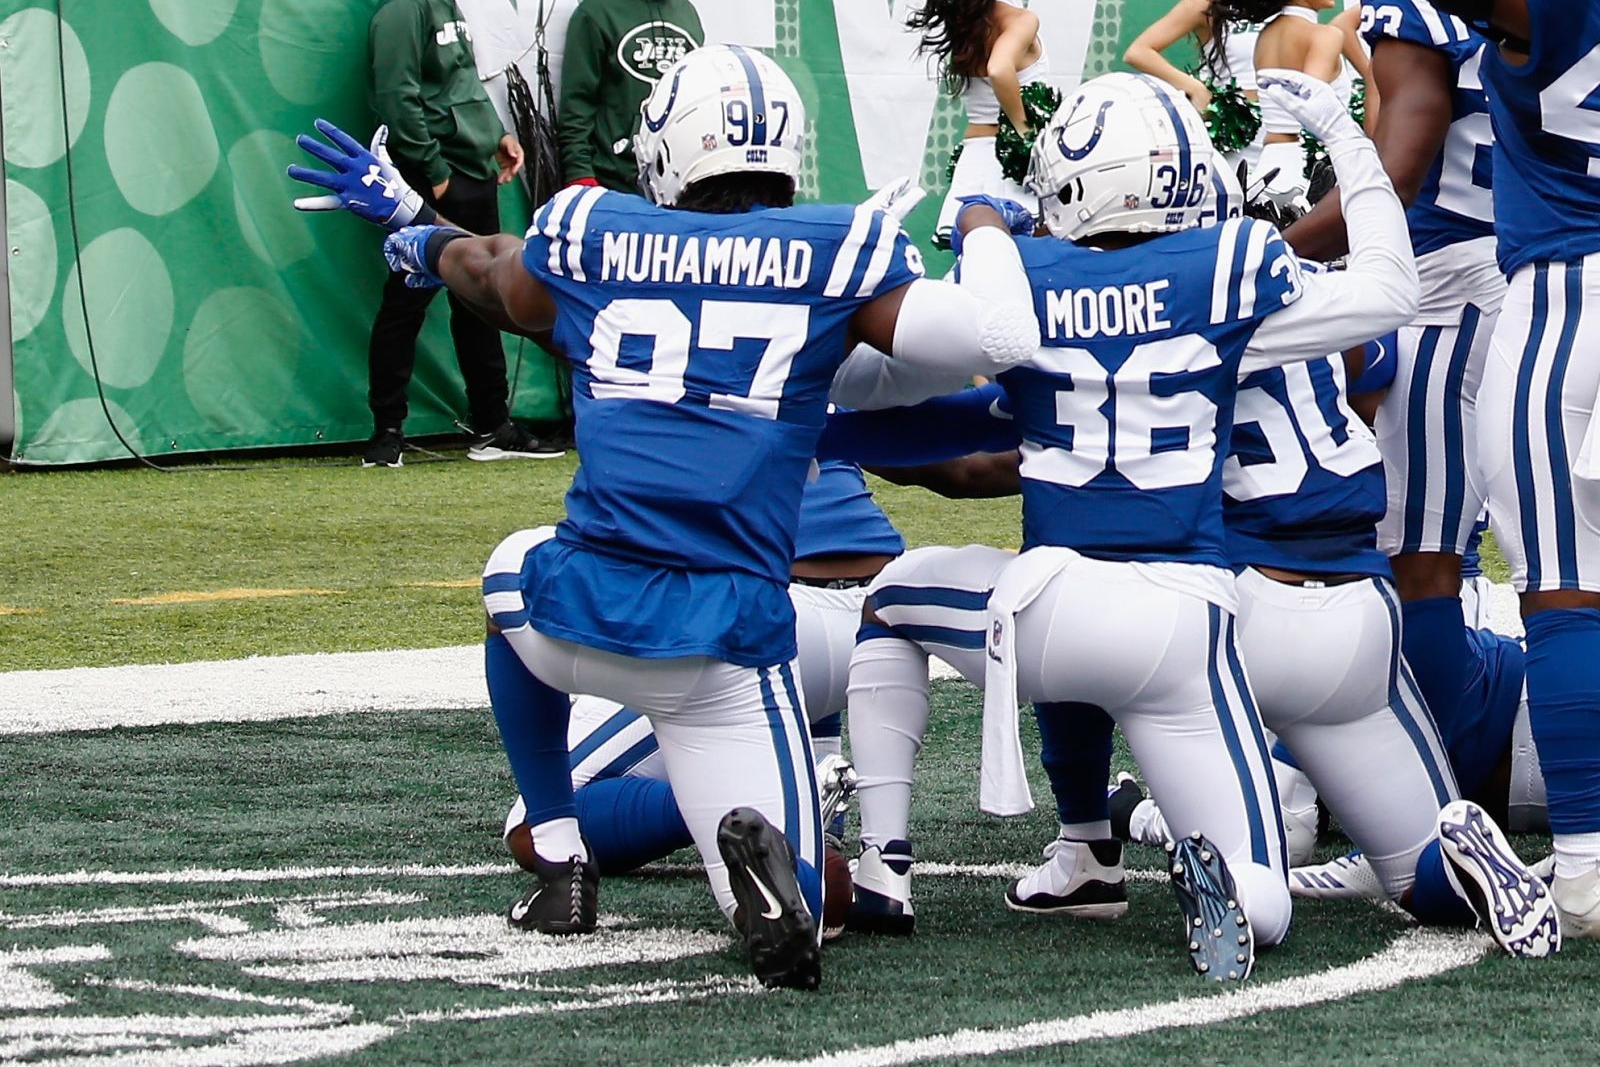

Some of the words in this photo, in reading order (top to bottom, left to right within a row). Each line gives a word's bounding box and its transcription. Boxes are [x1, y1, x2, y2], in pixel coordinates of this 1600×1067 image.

[726, 98, 790, 148] 97
[745, 149, 768, 164] COLTS
[1151, 163, 1208, 209] 36
[1164, 213, 1185, 226] COLTS
[600, 229, 813, 290] MUHAMMAD
[1046, 278, 1172, 340] MOORE
[586, 297, 811, 421] 97
[1018, 333, 1224, 491] 36
